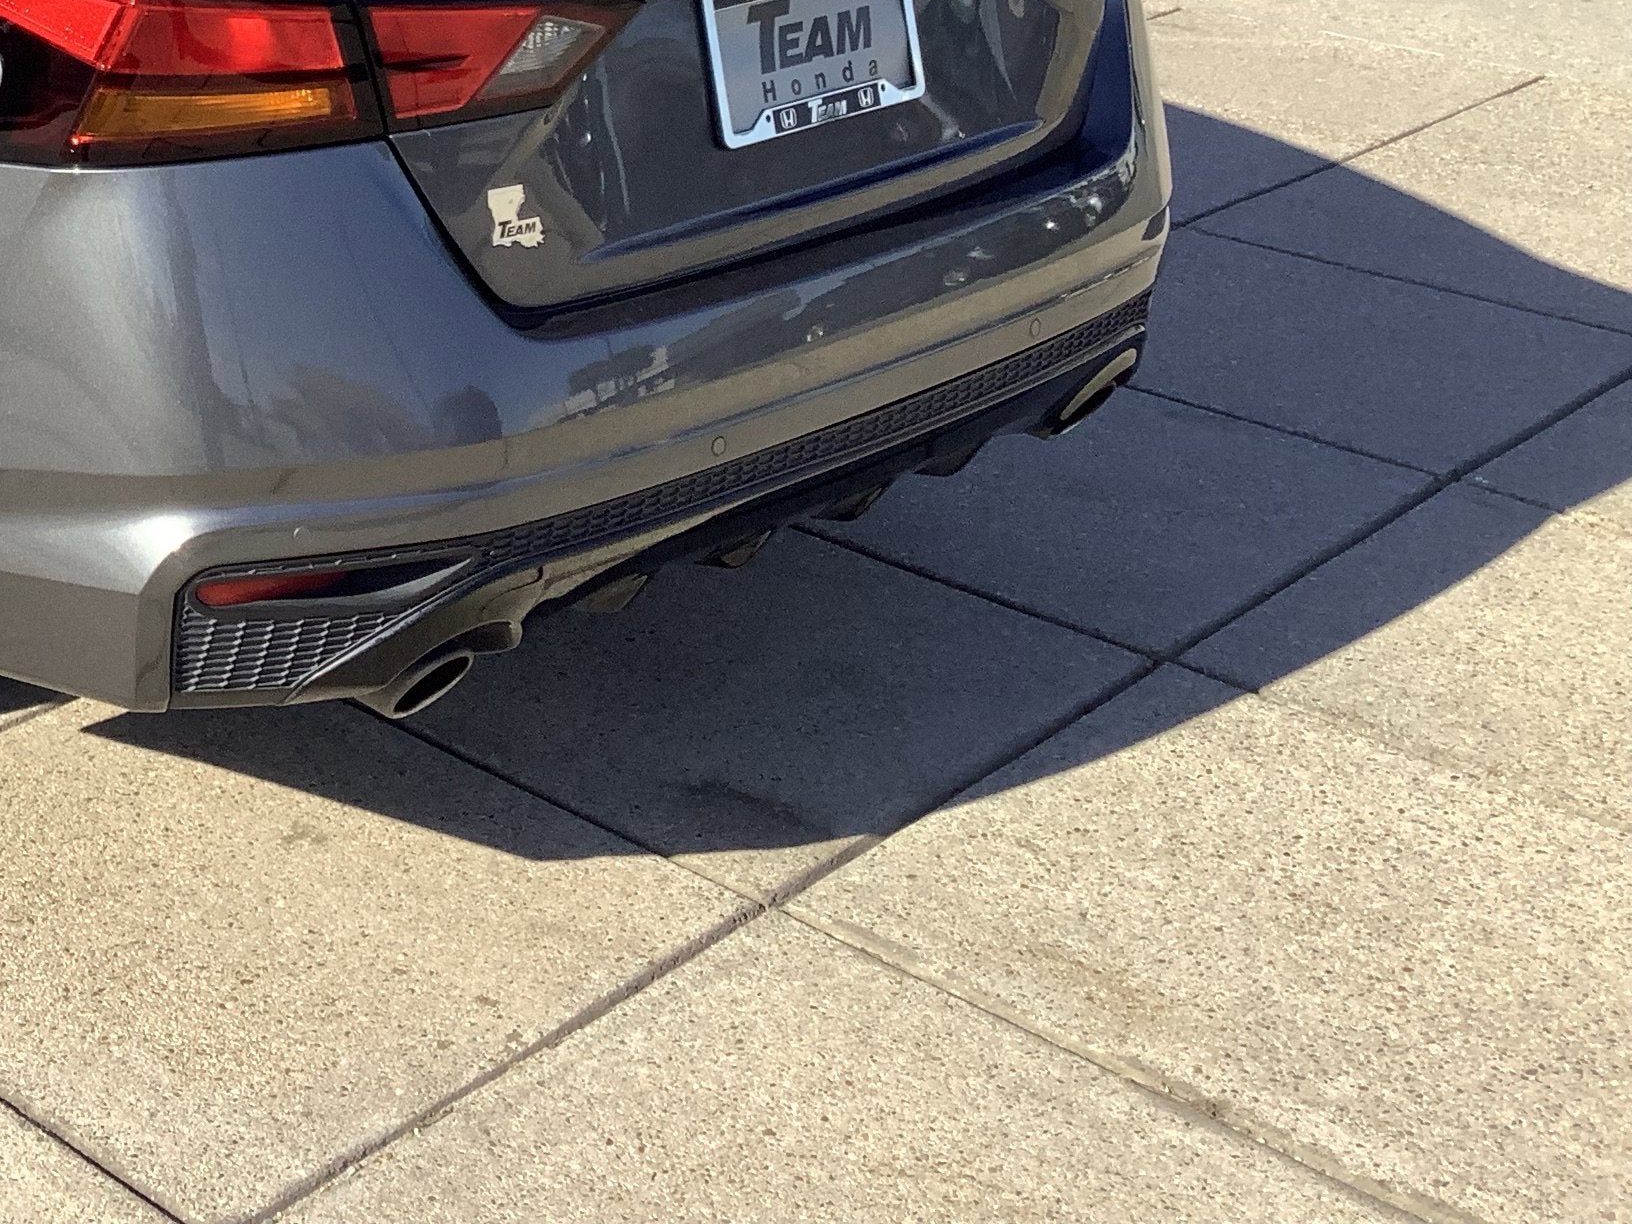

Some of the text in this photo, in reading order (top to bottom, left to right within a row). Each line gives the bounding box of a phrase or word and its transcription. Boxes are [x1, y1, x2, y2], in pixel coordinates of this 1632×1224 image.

[761, 59, 879, 103] Honda
[808, 98, 847, 123] TEAM
[498, 220, 536, 239] TEAM
